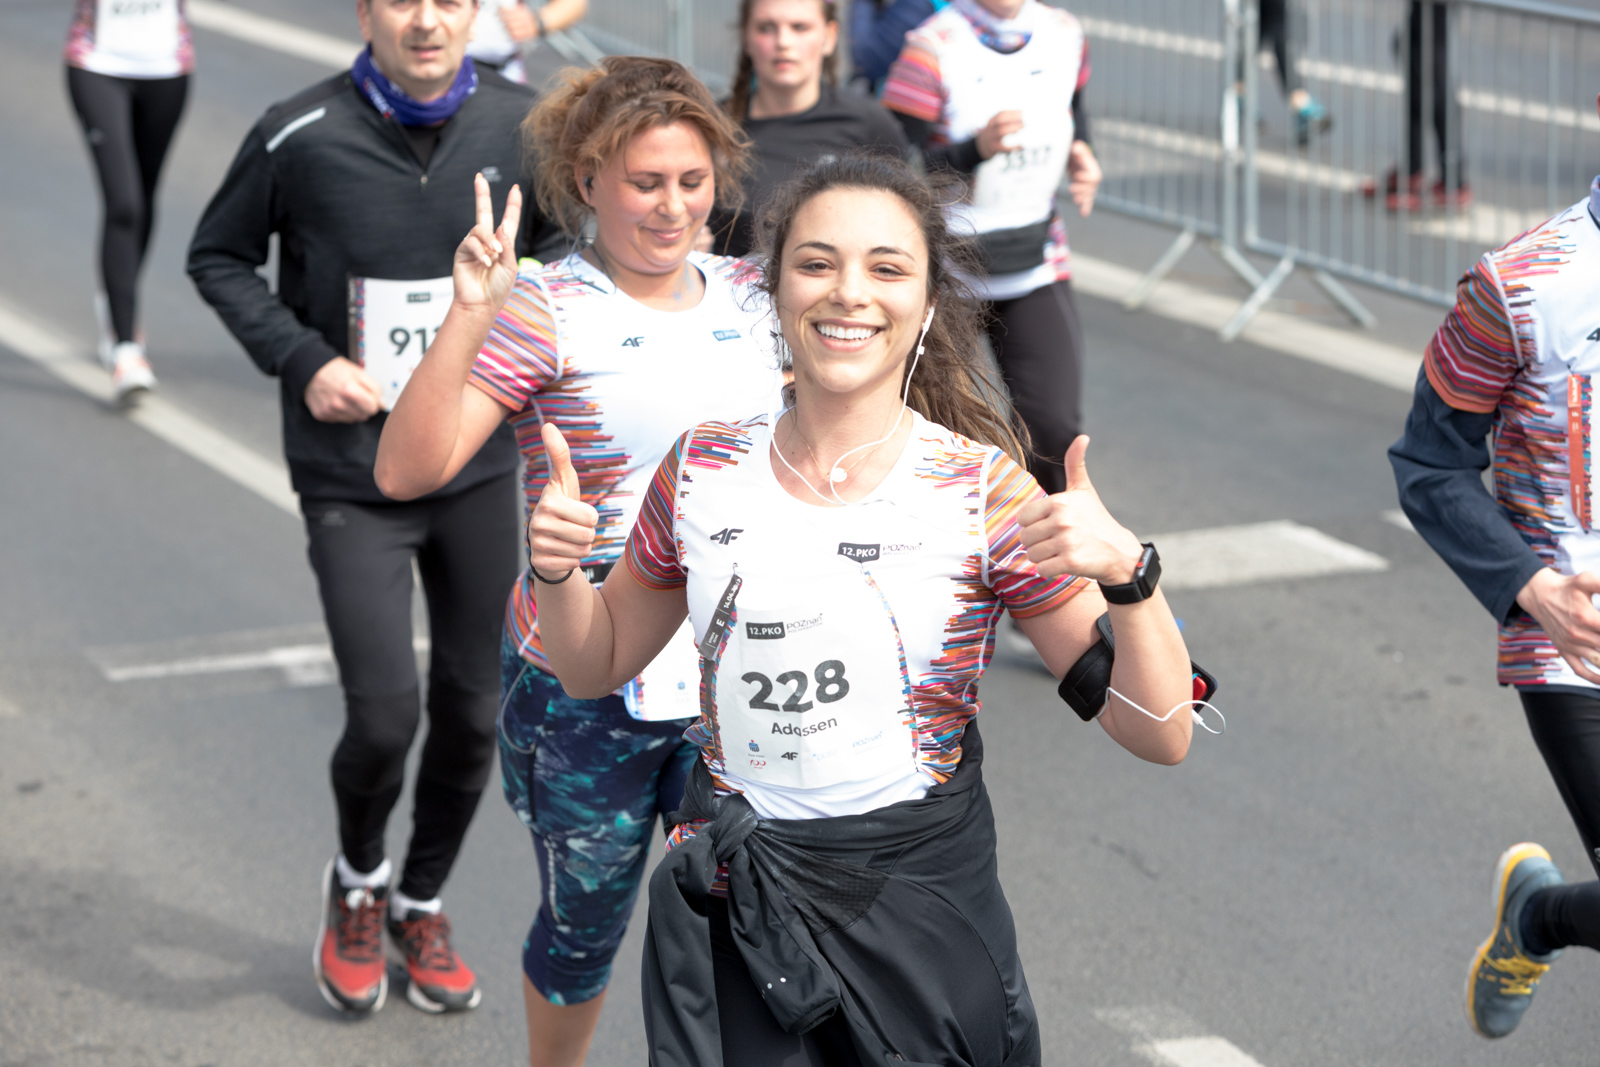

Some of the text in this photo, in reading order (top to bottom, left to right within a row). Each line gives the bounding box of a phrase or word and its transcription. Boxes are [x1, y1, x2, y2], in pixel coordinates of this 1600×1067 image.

[1586, 327, 1600, 341] 4
[388, 327, 440, 356] 91
[621, 336, 644, 347] 4F
[710, 528, 744, 545] 4F
[841, 546, 877, 558] 12.PKO
[716, 618, 725, 627] E
[748, 626, 782, 636] 12.PKO
[741, 659, 850, 713] 228
[781, 752, 799, 761] 4F
